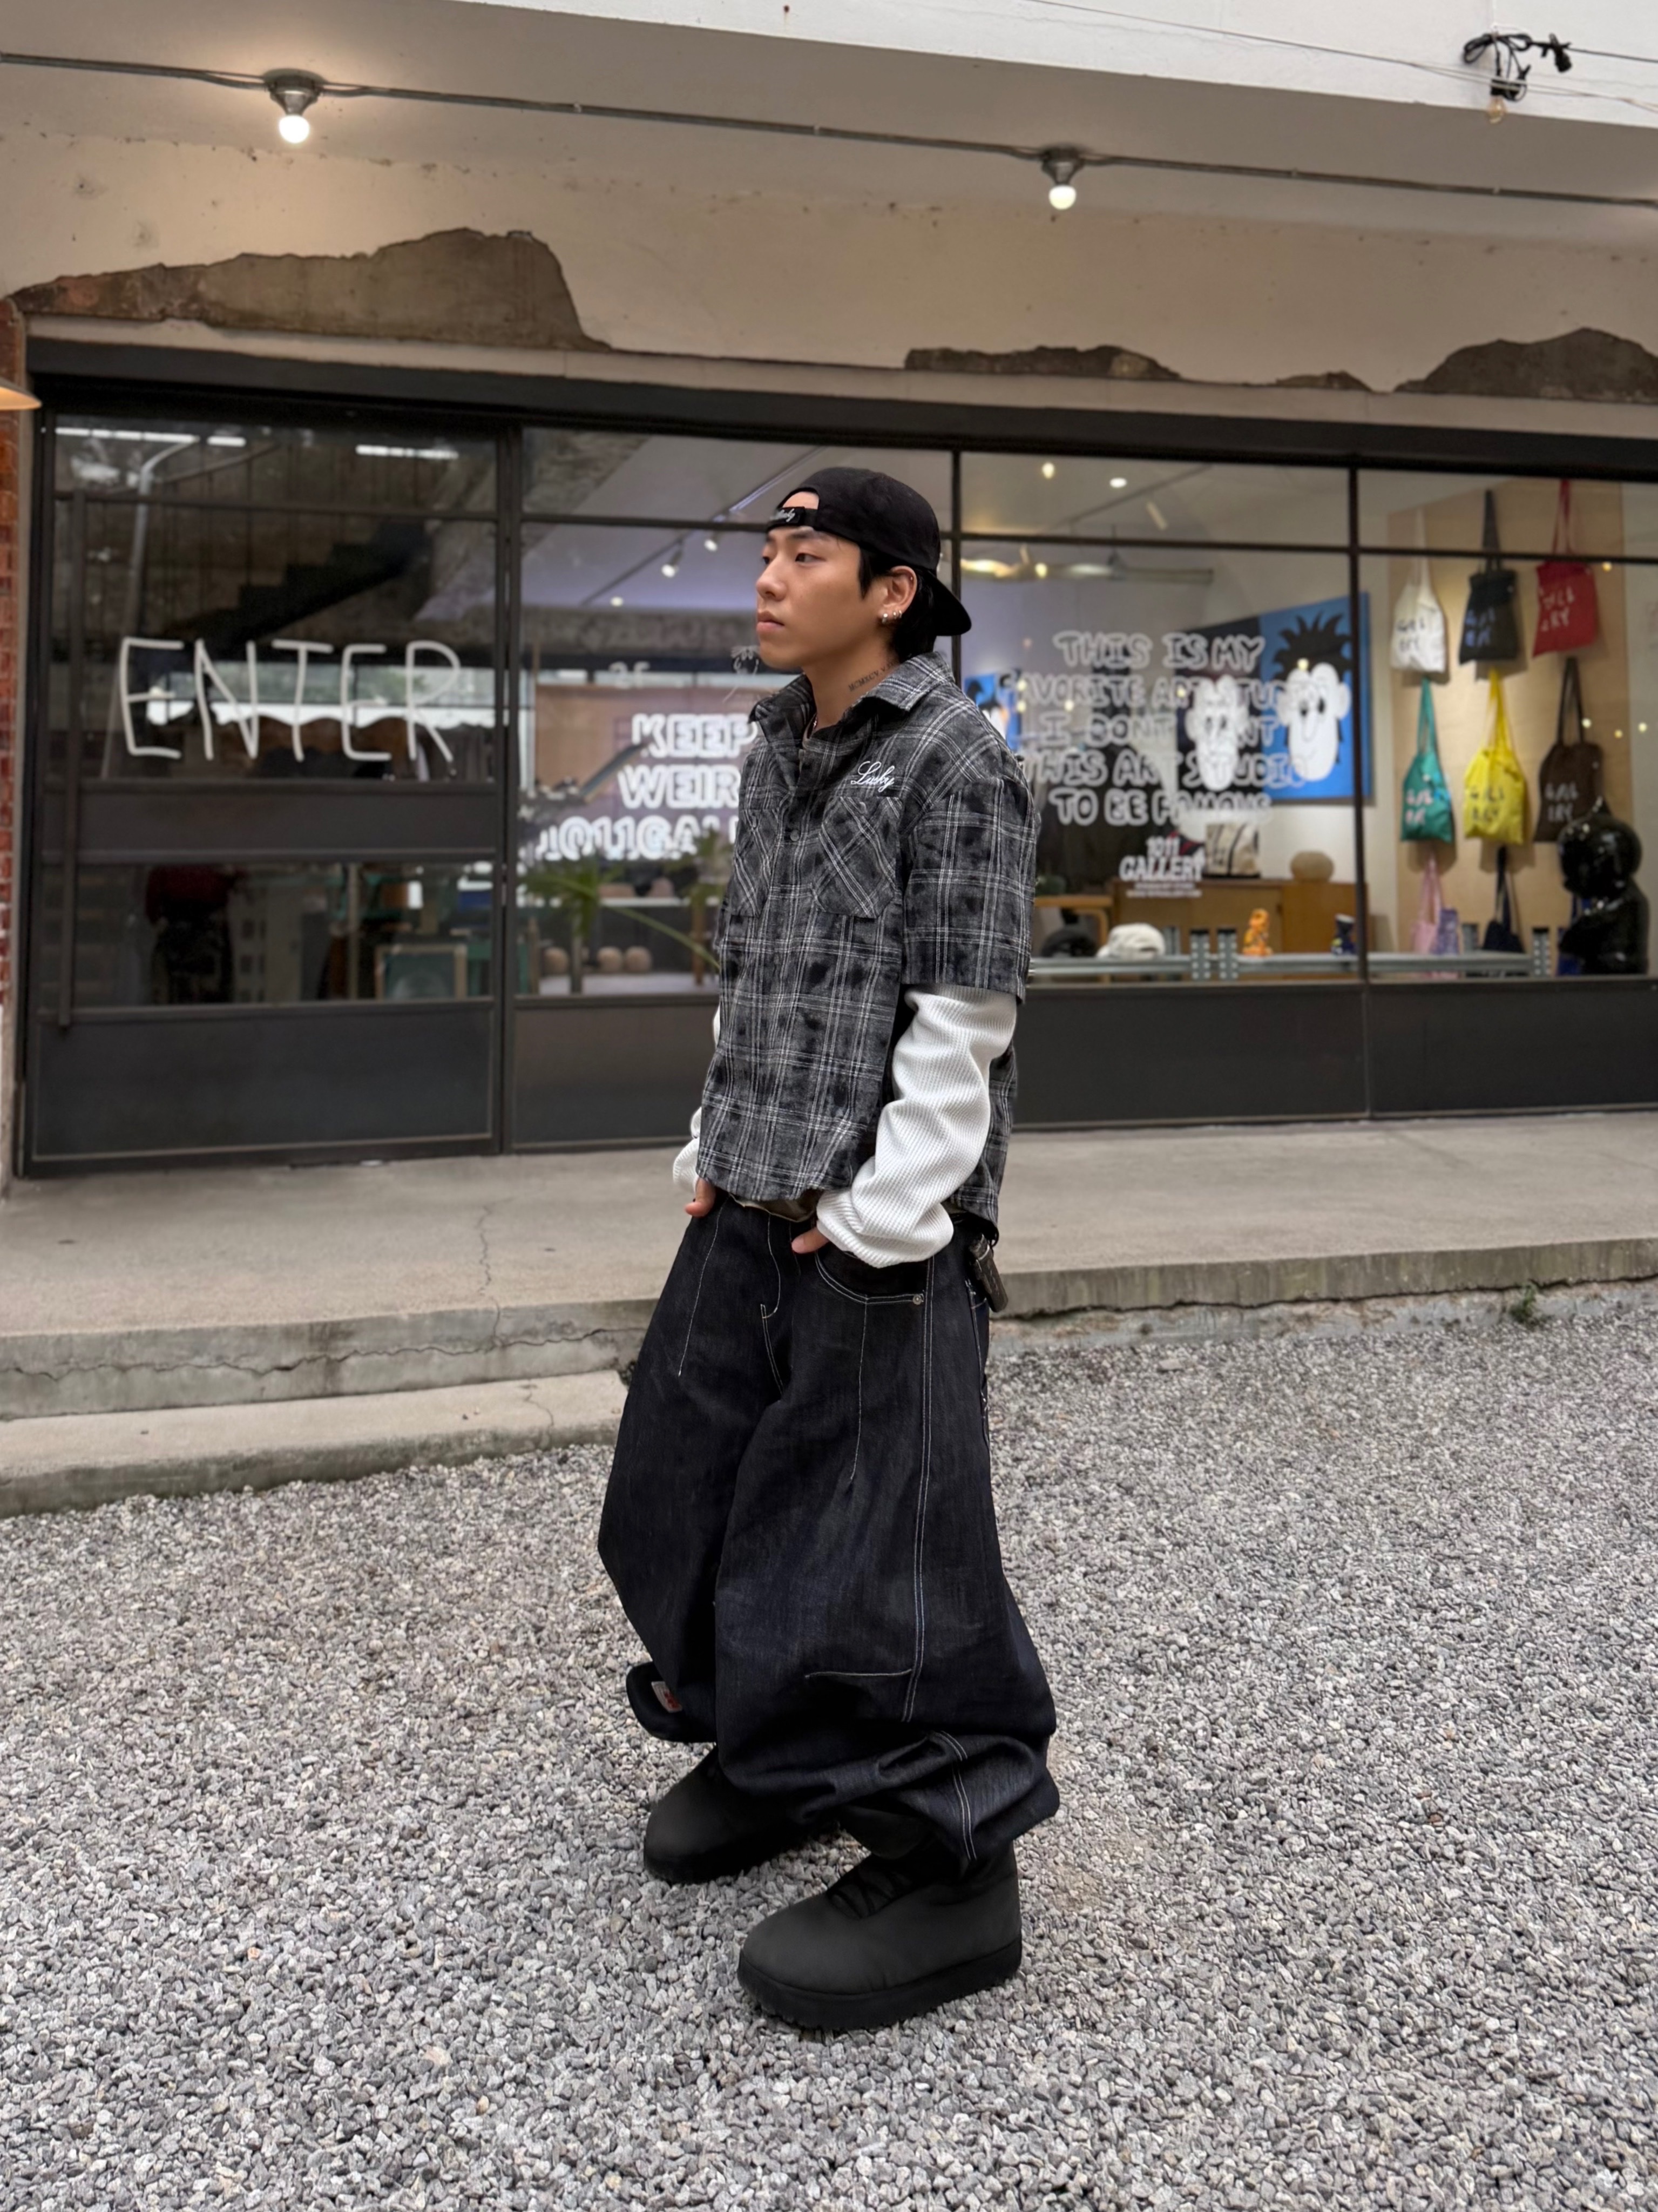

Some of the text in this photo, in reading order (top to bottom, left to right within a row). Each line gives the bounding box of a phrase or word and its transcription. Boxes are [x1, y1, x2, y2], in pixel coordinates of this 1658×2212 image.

[1052, 629, 1266, 672] THIS IS MY
[119, 636, 461, 762] ENTER
[632, 713, 758, 758] KEEP
[1038, 710, 1072, 747] I
[618, 765, 740, 809] WEIR
[1048, 787, 1098, 826] TO
[1105, 788, 1150, 826] BE
